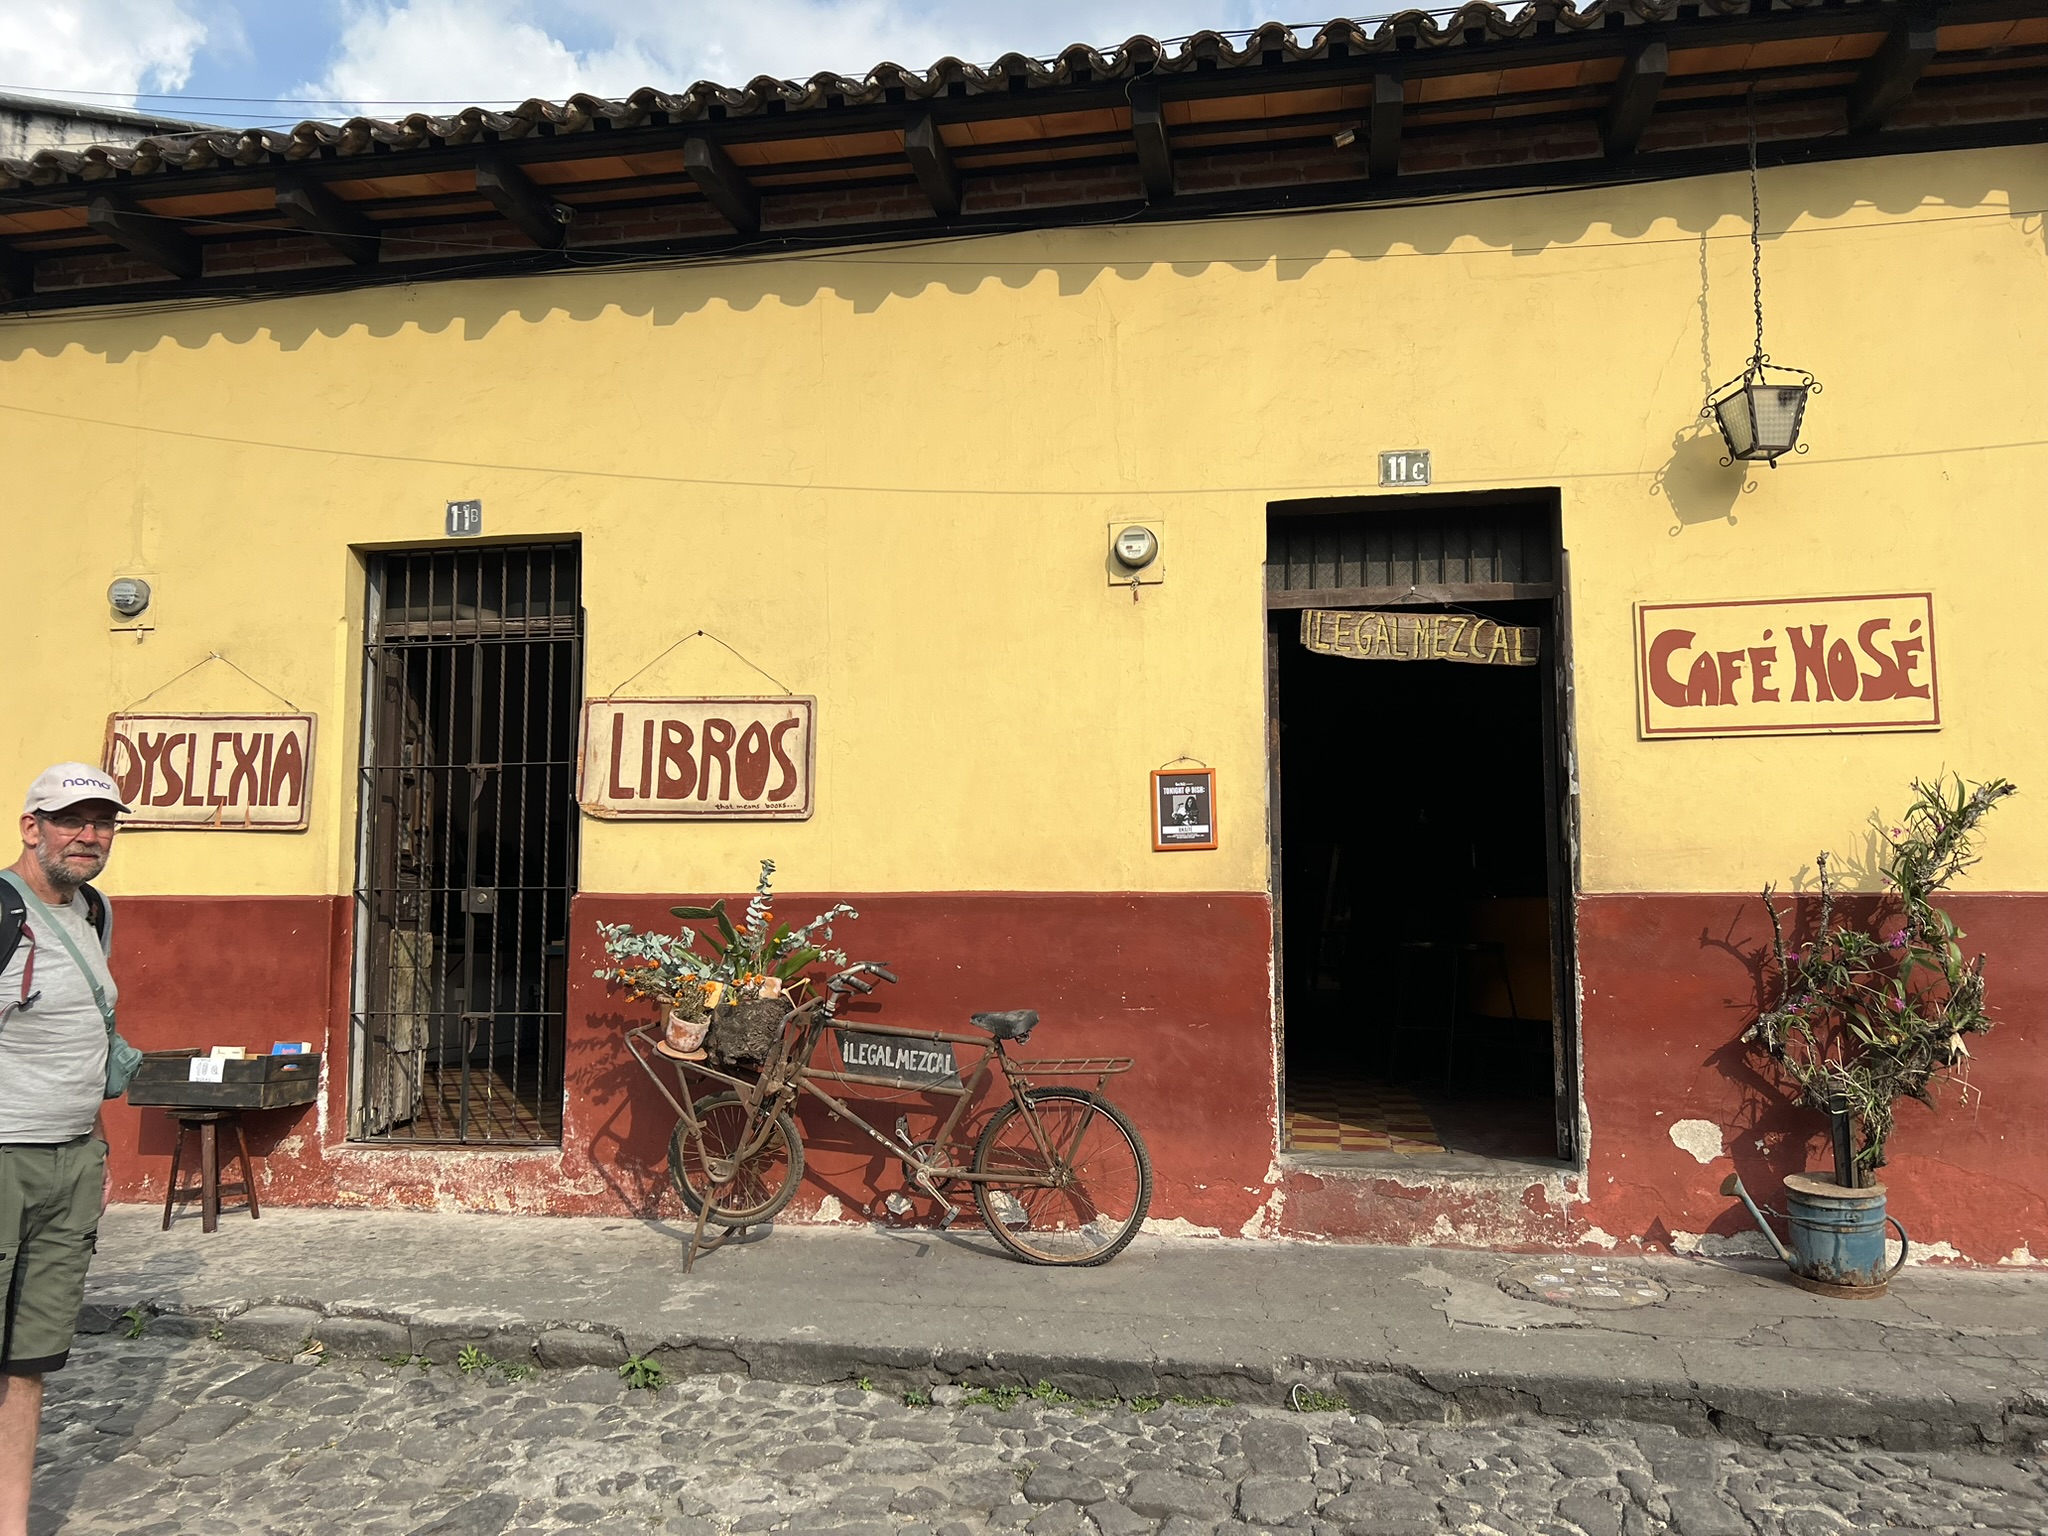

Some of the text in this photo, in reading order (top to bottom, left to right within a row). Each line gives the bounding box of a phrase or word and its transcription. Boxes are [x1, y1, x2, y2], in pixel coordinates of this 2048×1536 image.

[1388, 456, 1407, 481] 11
[1305, 610, 1537, 664] ILEGAL MEZCAL
[1649, 628, 1780, 708] CAFÉ
[110, 730, 303, 807] DYSLEXIA
[608, 712, 800, 801] LIBROS
[895, 1048, 956, 1075] MEZCAL
